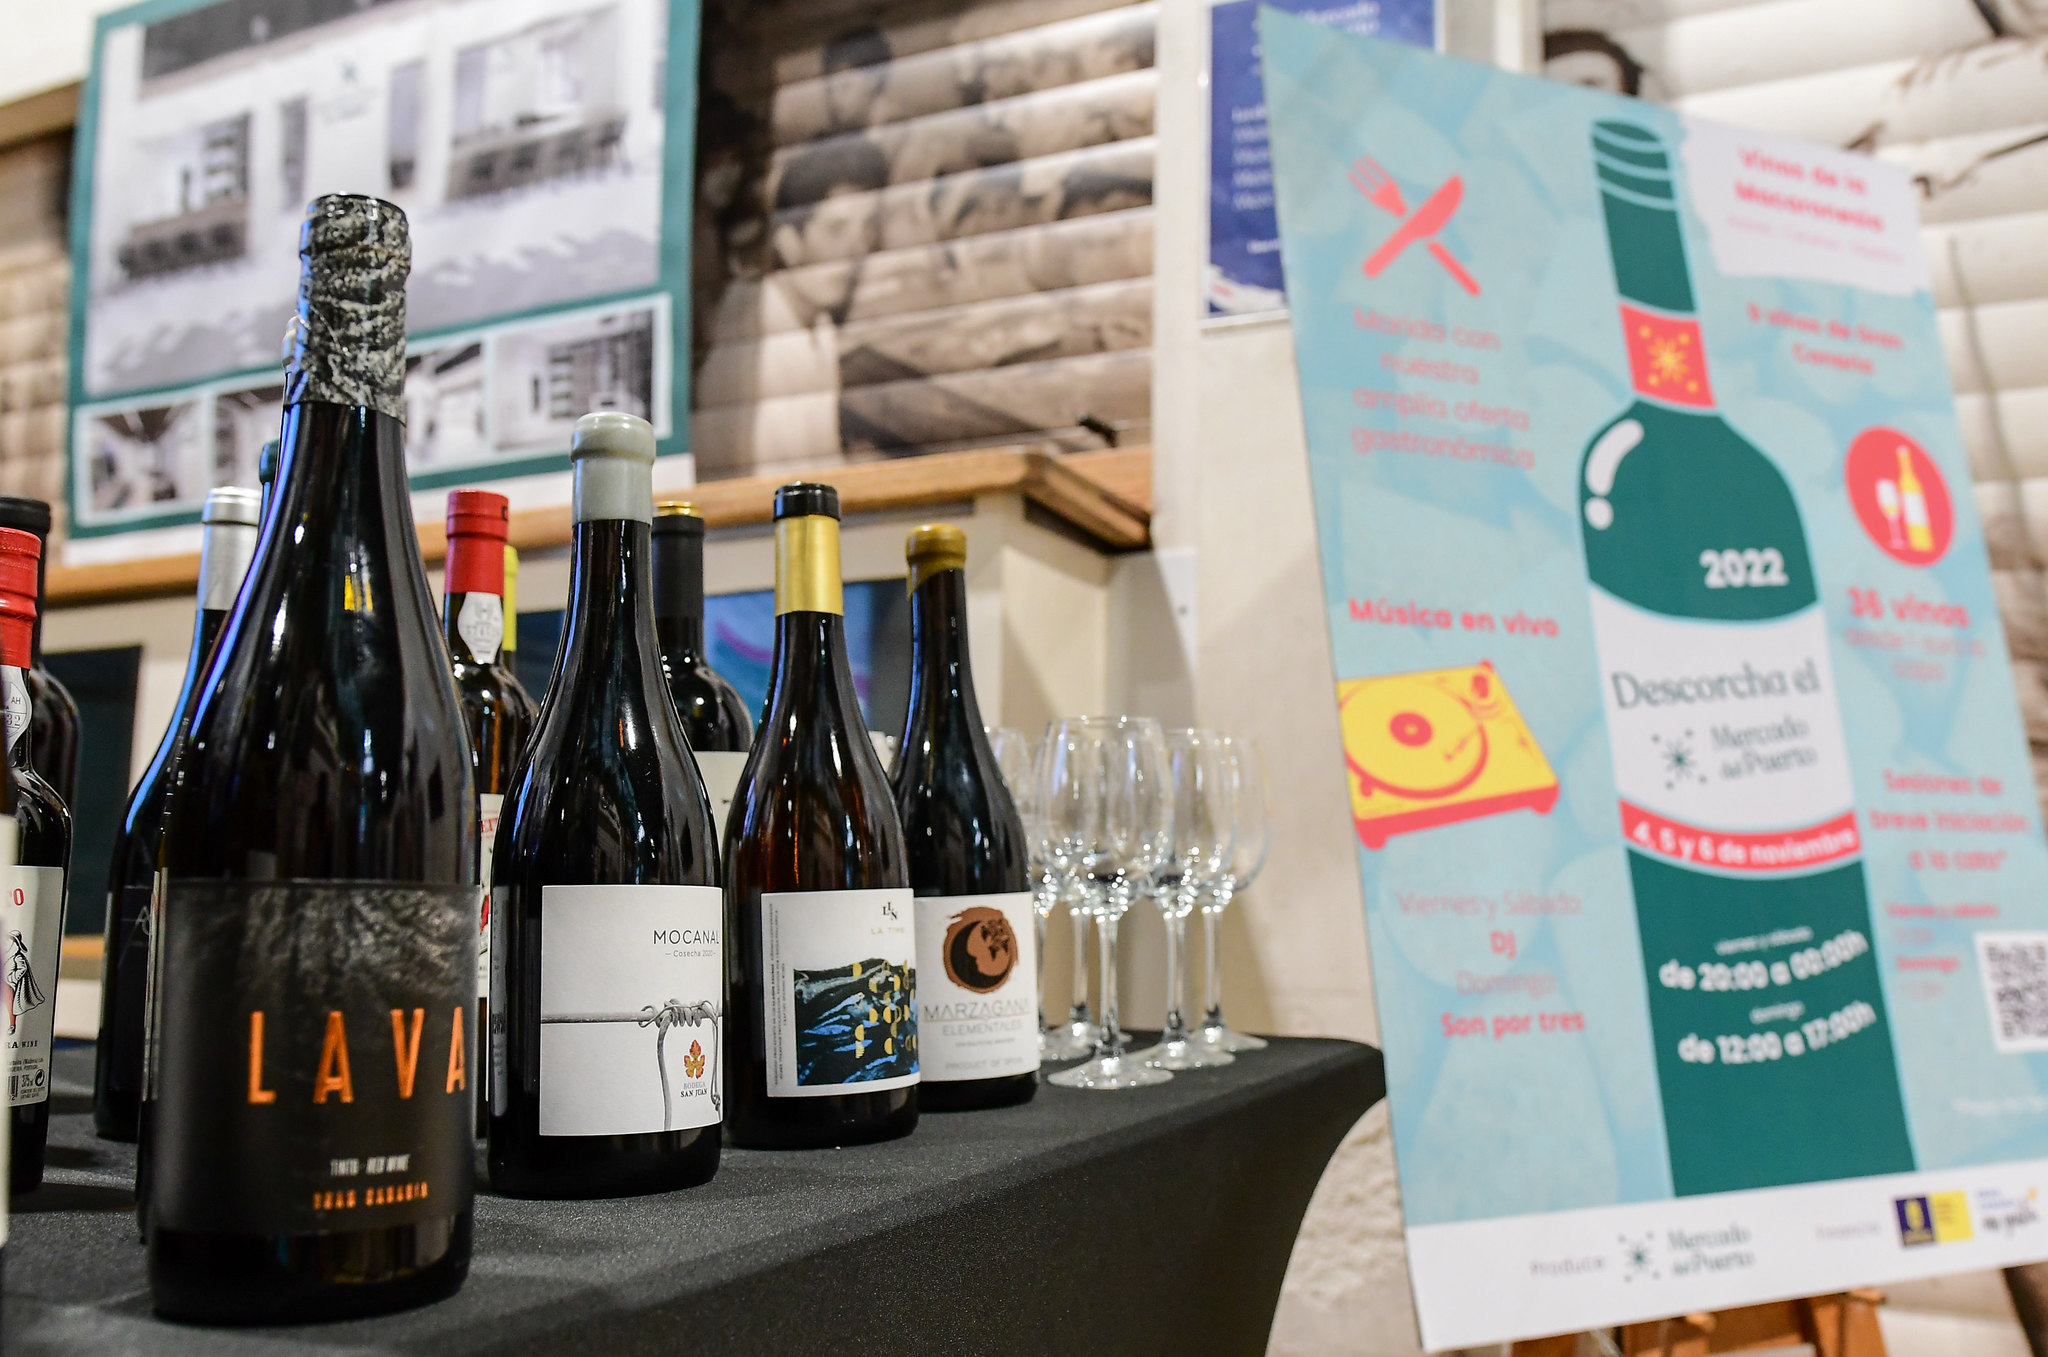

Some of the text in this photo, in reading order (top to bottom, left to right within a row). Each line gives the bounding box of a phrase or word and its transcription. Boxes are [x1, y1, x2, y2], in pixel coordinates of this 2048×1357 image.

[1699, 547, 1789, 589] 2022
[1349, 596, 1559, 638] Música en vivo
[1611, 655, 1823, 710] Descorcha el
[1710, 714, 1809, 751] Mercado
[1742, 745, 1818, 776] Puerto
[1679, 835, 1695, 862] y
[1717, 839, 1748, 865] de
[1749, 827, 1857, 866] noviembre
[672, 949, 701, 958] Cosecha
[1490, 930, 1517, 960] DJ
[1658, 958, 1697, 991] de
[1697, 960, 1770, 992] 20:00
[1769, 960, 1793, 987] a
[942, 1019, 1024, 1037] ELEMENTALES
[1441, 1010, 1586, 1041] Son por tres
[247, 1006, 467, 1104] LAVA
[1677, 1032, 1716, 1065] de
[1715, 1031, 1783, 1065] 12:00
[1782, 1031, 1806, 1057] a
[680, 1088, 708, 1098] SAN JUAN
[683, 1081, 706, 1090] BODEGA
